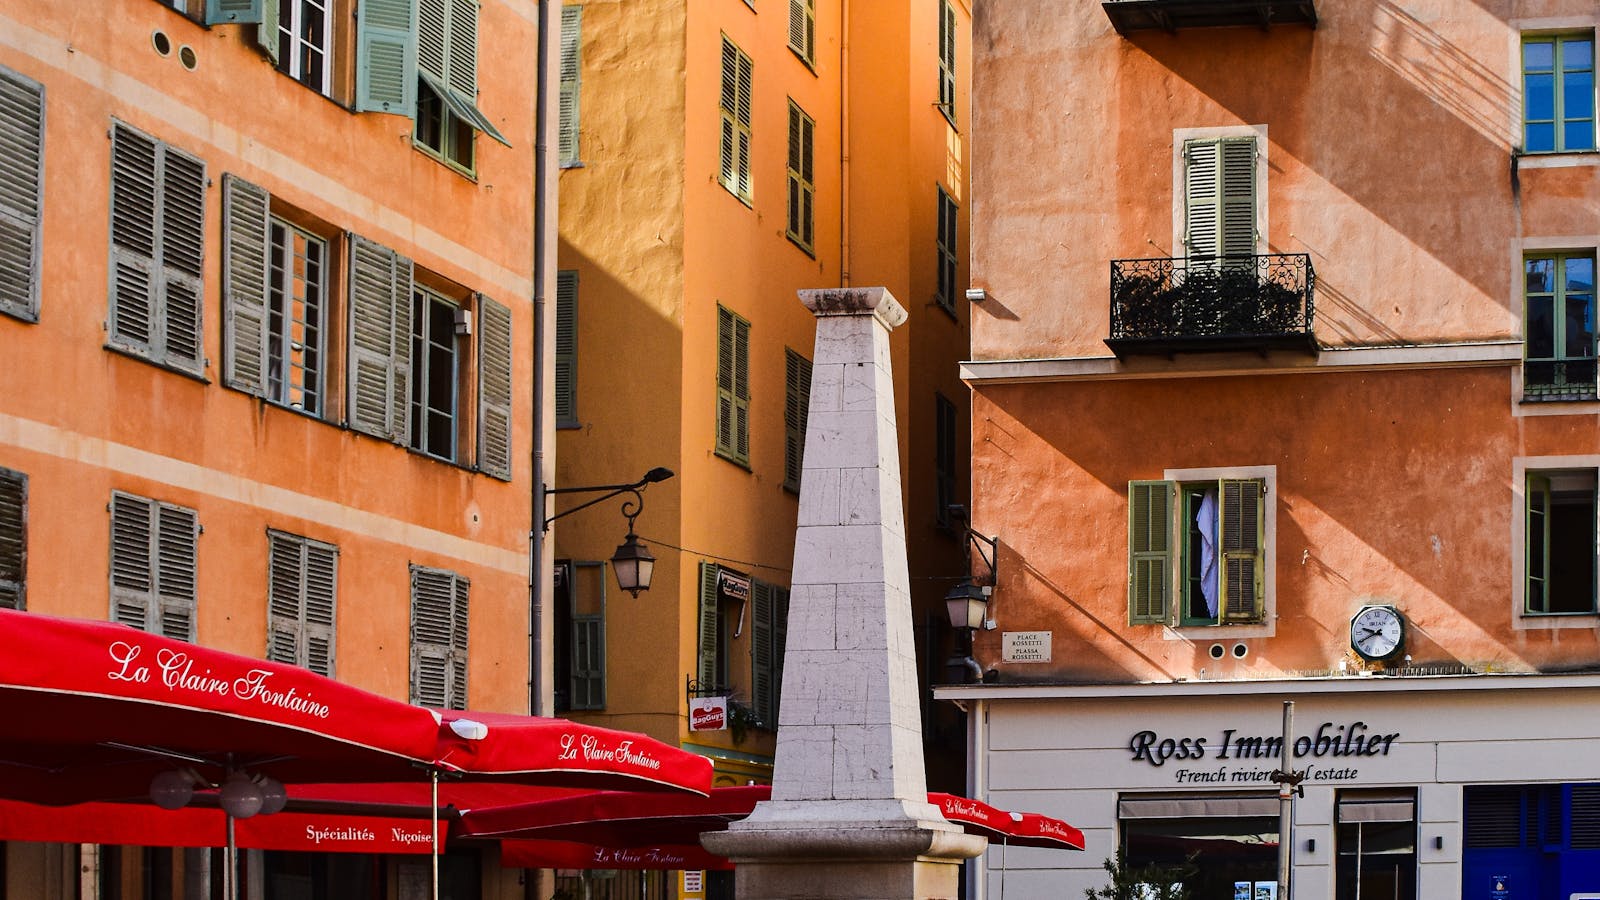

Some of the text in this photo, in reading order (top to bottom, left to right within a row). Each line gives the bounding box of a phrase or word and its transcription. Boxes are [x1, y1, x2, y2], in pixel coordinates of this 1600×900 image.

[107, 641, 330, 719] La Claire Fontaine
[558, 734, 660, 770] La Claire Fontaine
[1130, 721, 1400, 767] Ross Immobilier
[1175, 766, 1227, 783] French
[1231, 766, 1272, 782] rivier
[1314, 767, 1358, 781] estate
[306, 825, 433, 844] Spécialités Niçoise
[593, 846, 610, 863] La
